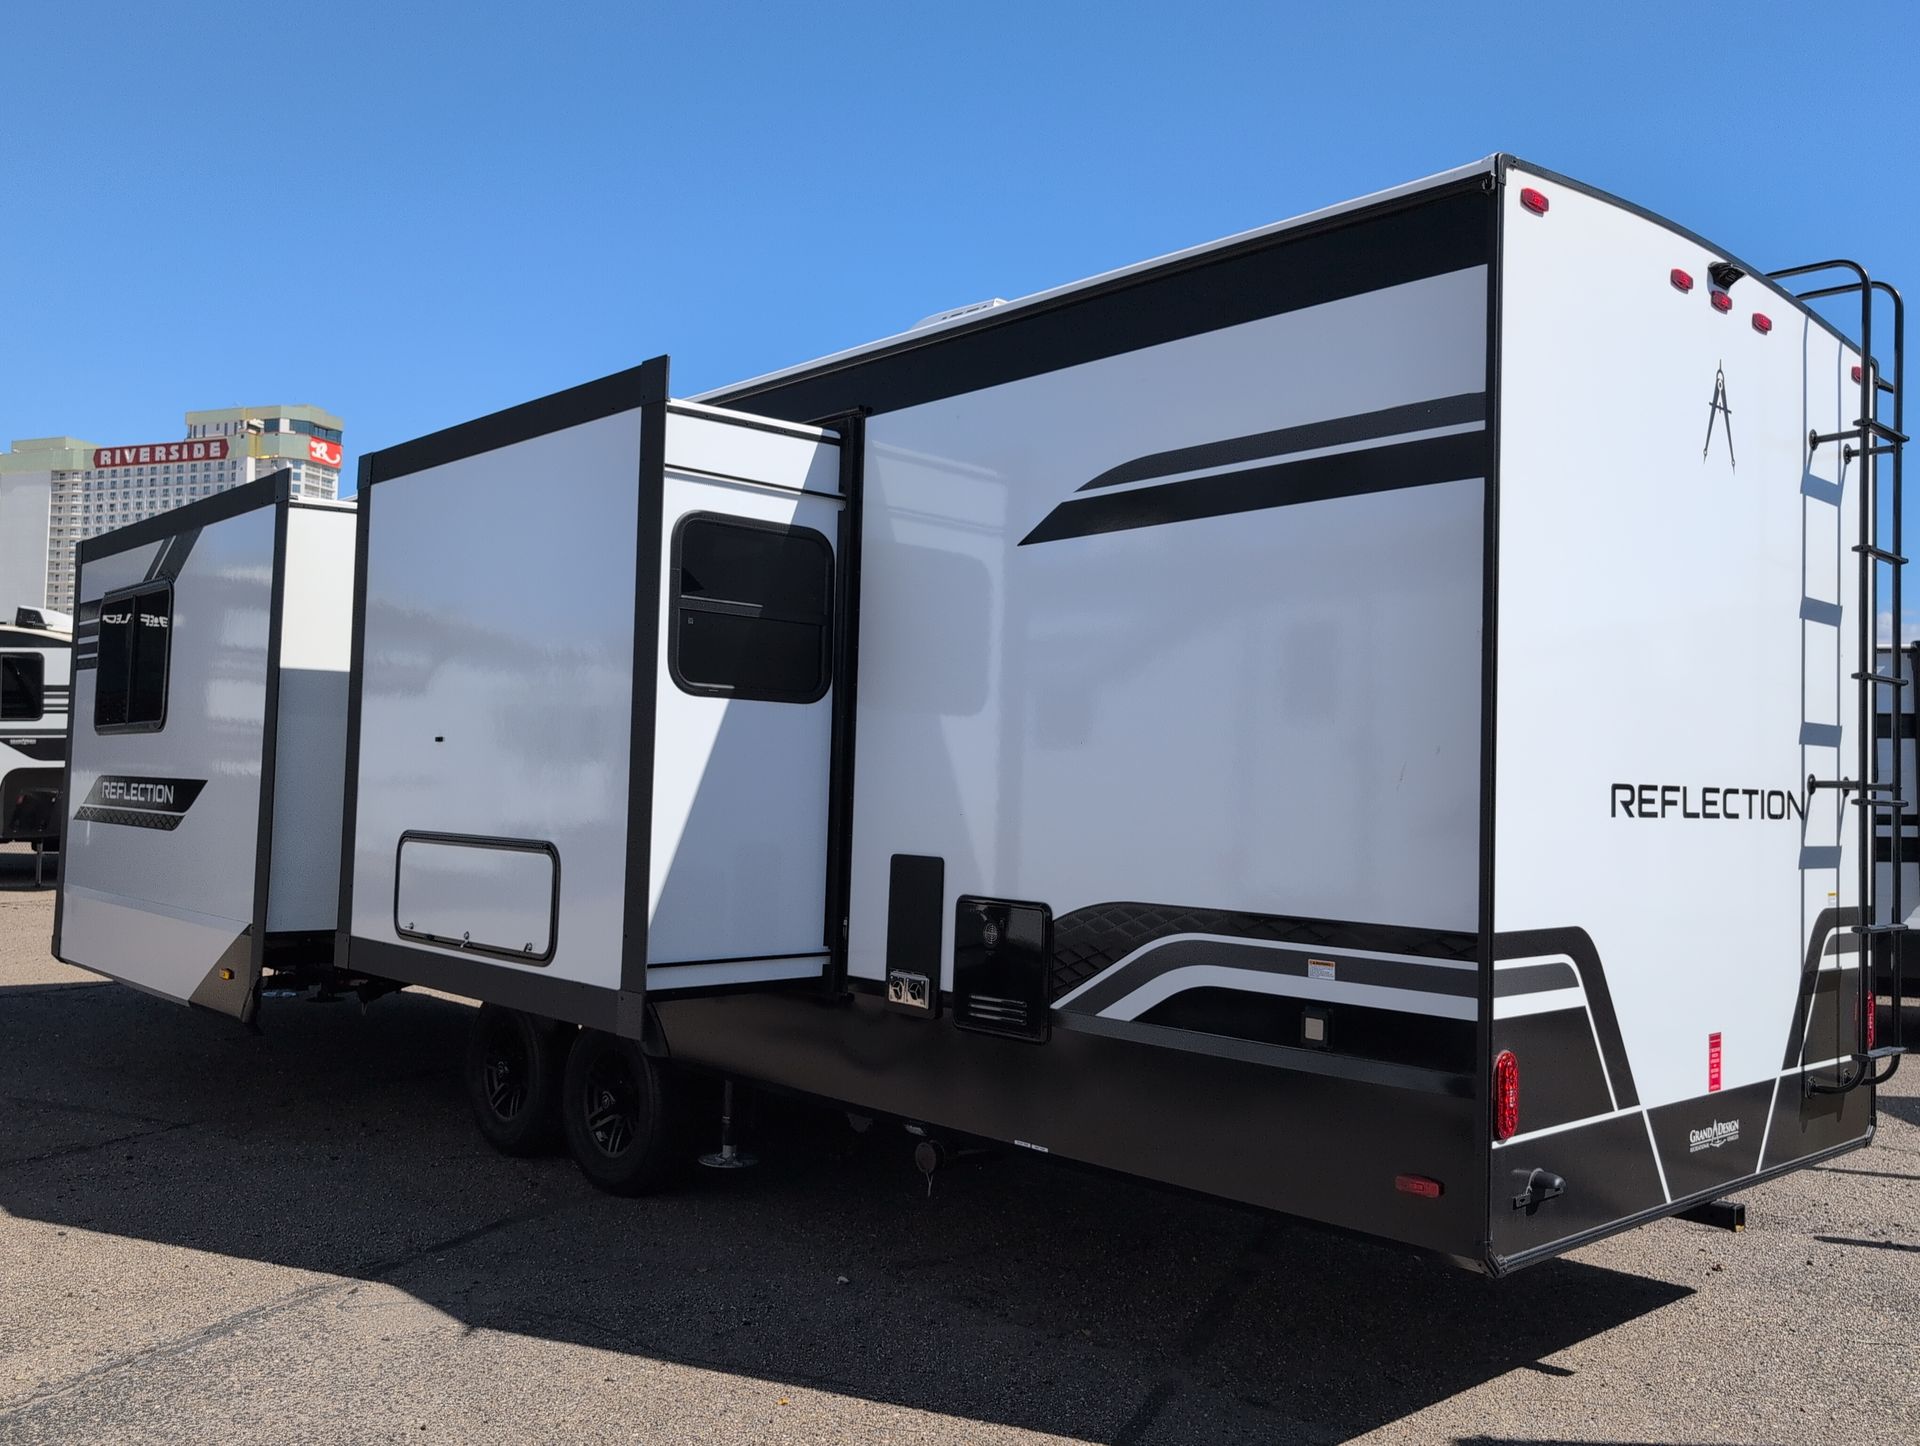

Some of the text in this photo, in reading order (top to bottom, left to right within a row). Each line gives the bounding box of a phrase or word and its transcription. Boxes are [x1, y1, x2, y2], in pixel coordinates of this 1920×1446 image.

[100, 441, 220, 465] RIVERSIDE
[101, 782, 174, 804] REFLECTION
[1611, 783, 1805, 820] REFLECTION
